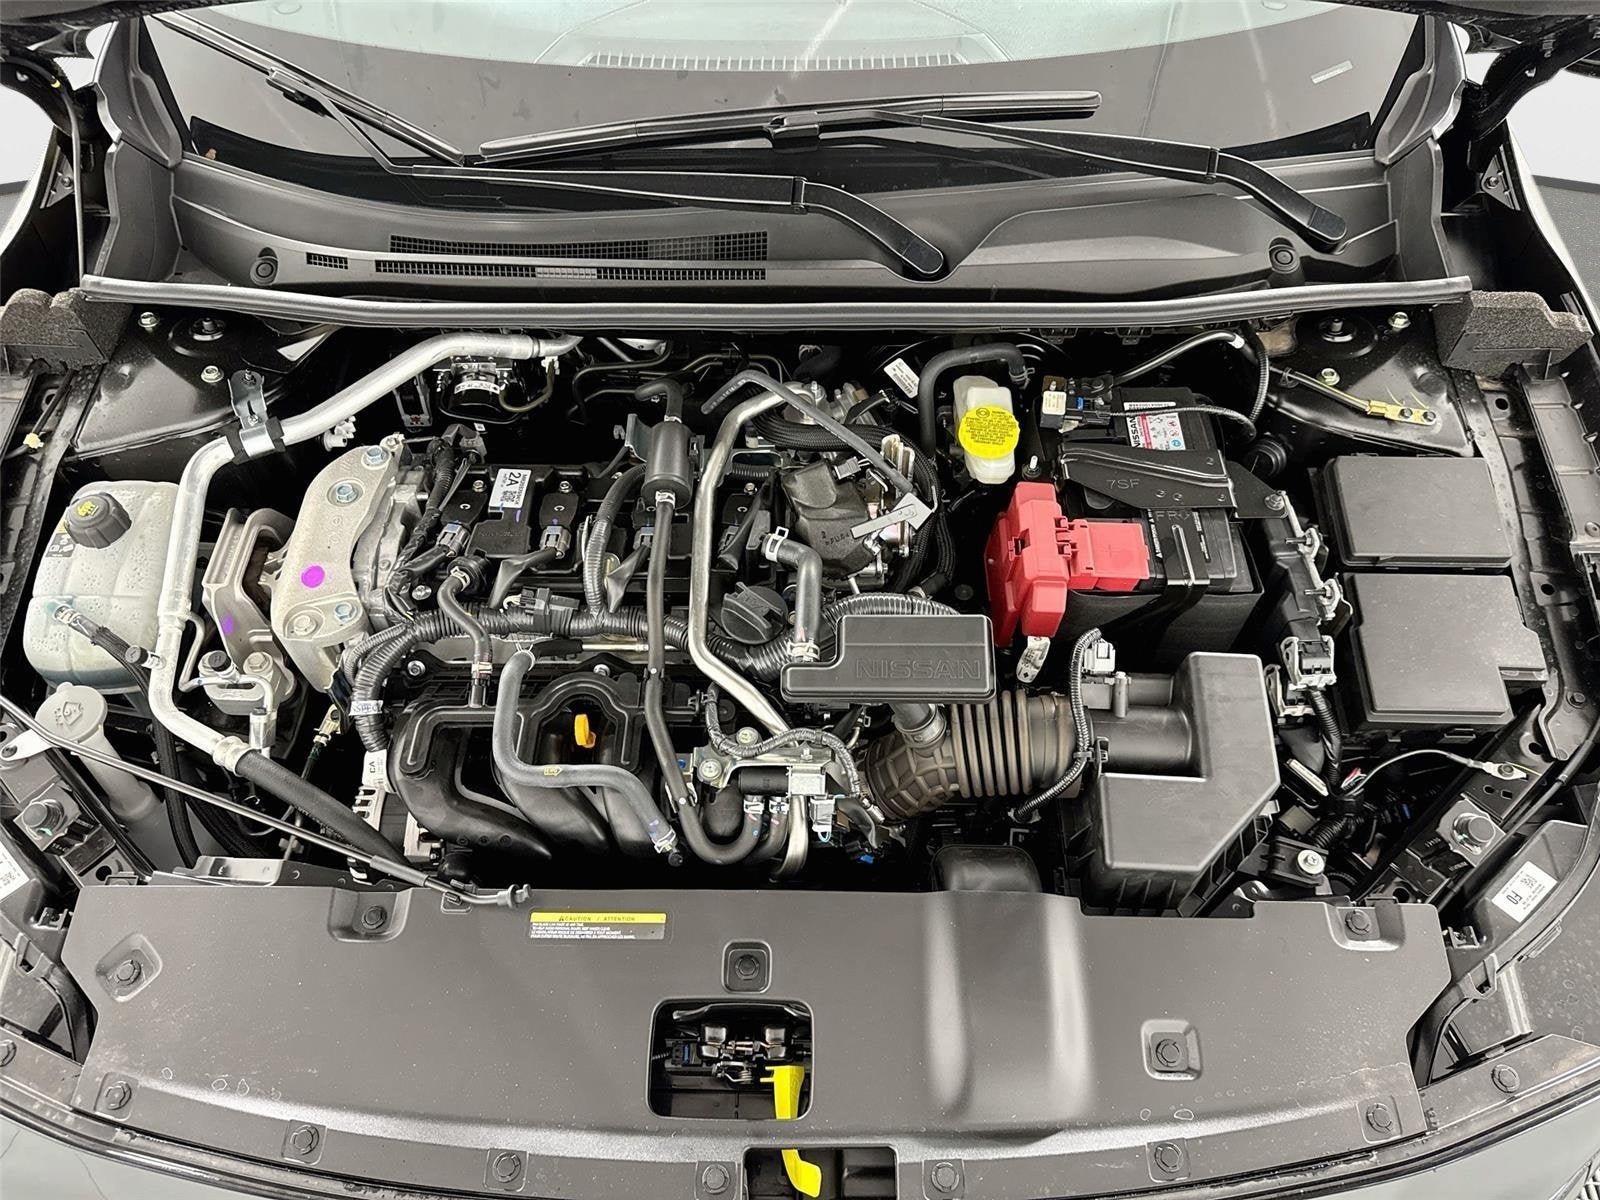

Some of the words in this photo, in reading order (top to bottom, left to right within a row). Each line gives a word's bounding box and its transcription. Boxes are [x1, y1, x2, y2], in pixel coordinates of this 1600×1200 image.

[506, 472, 521, 486] 2A
[1106, 478, 1140, 490] 7SF
[856, 659, 982, 680] NISSAN
